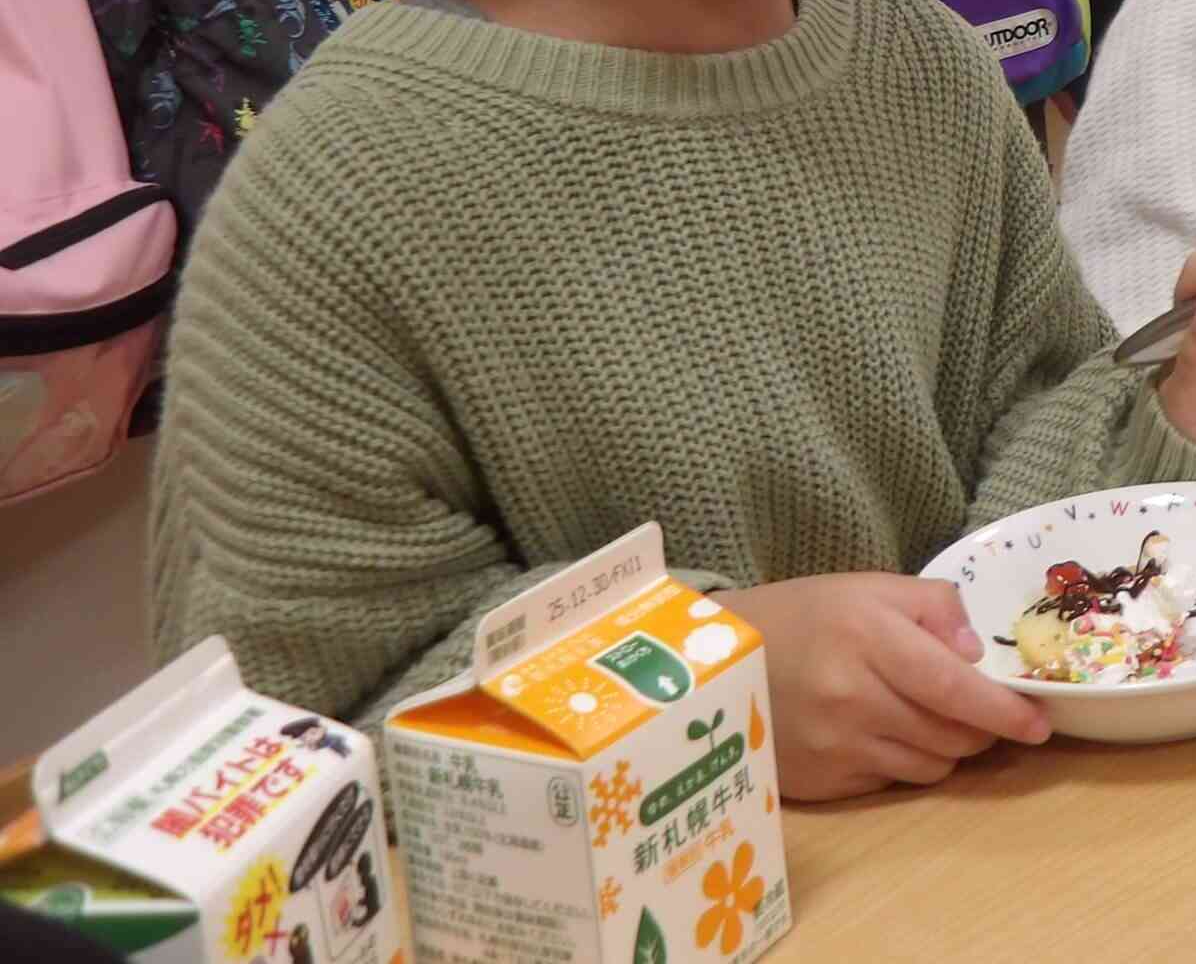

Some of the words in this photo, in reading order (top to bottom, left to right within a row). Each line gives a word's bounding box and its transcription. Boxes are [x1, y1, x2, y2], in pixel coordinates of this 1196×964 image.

[984, 18, 1048, 46] UTDOOR
[1064, 504, 1076, 521] V
[1110, 500, 1130, 517] W
[633, 765, 756, 876] 新札幌牛乳
